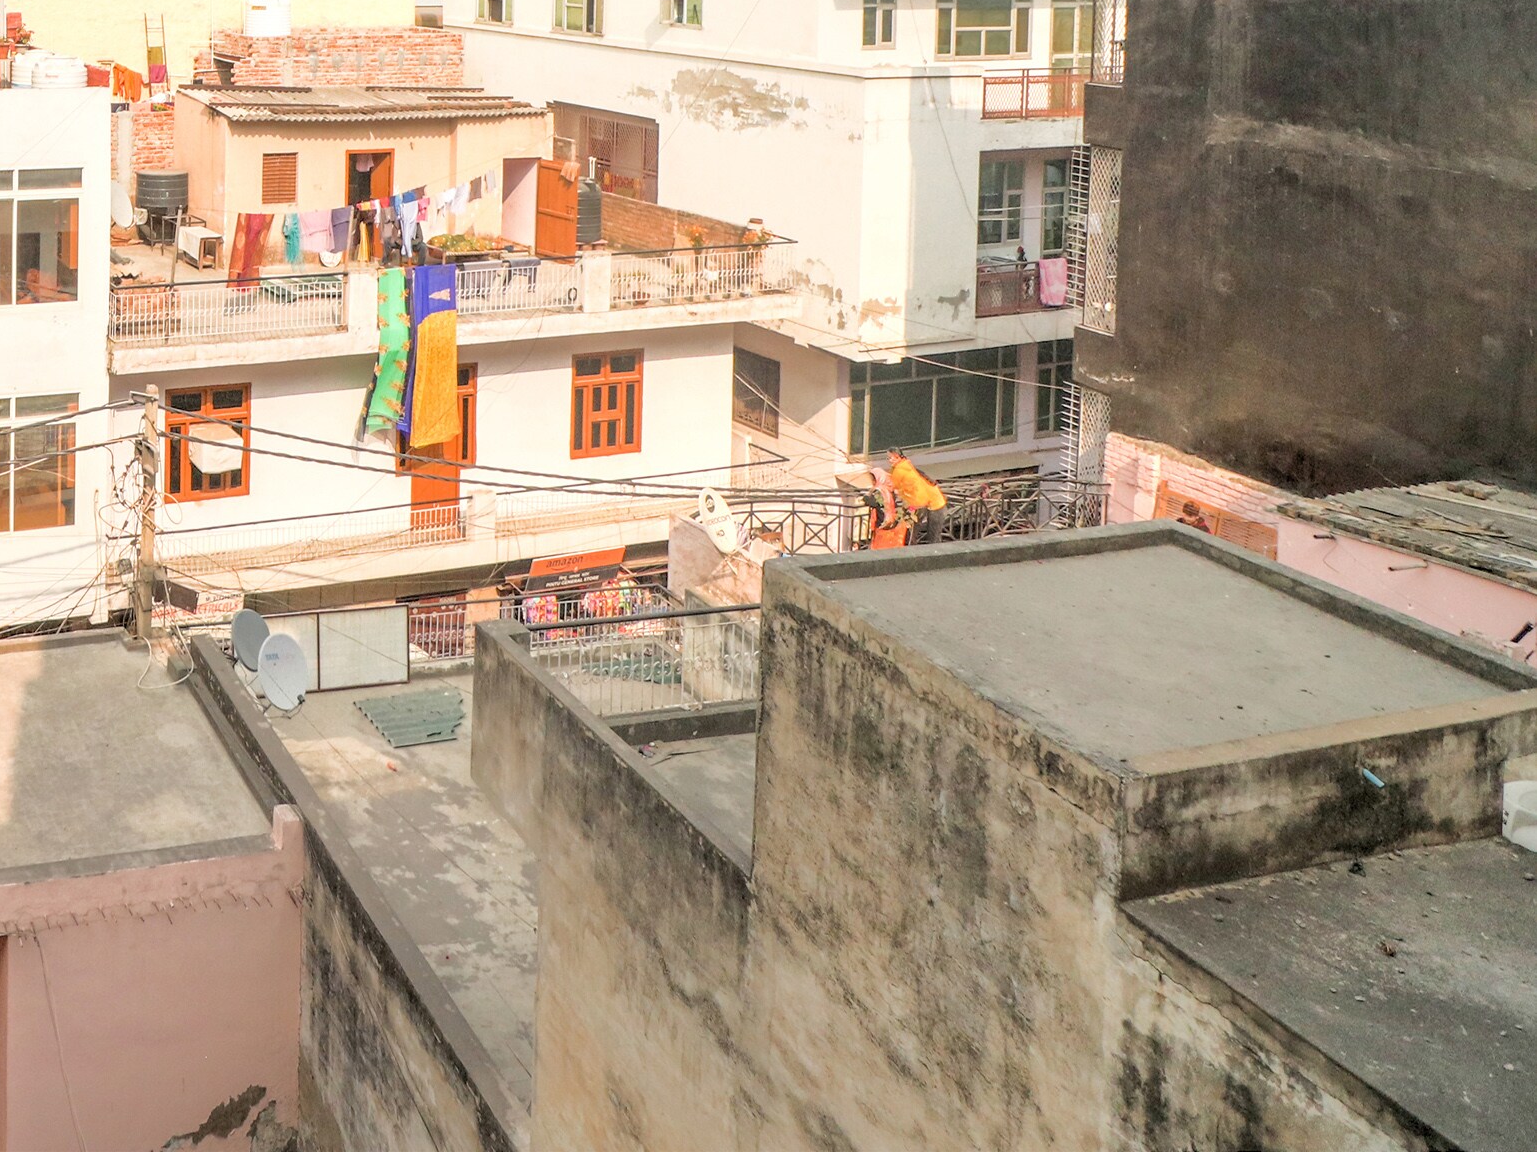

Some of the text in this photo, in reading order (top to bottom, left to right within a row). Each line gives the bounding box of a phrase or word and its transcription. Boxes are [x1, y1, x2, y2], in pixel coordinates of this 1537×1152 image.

[546, 556, 583, 568] amazon
[561, 577, 583, 586] GENERAL
[265, 653, 279, 661] TATA
